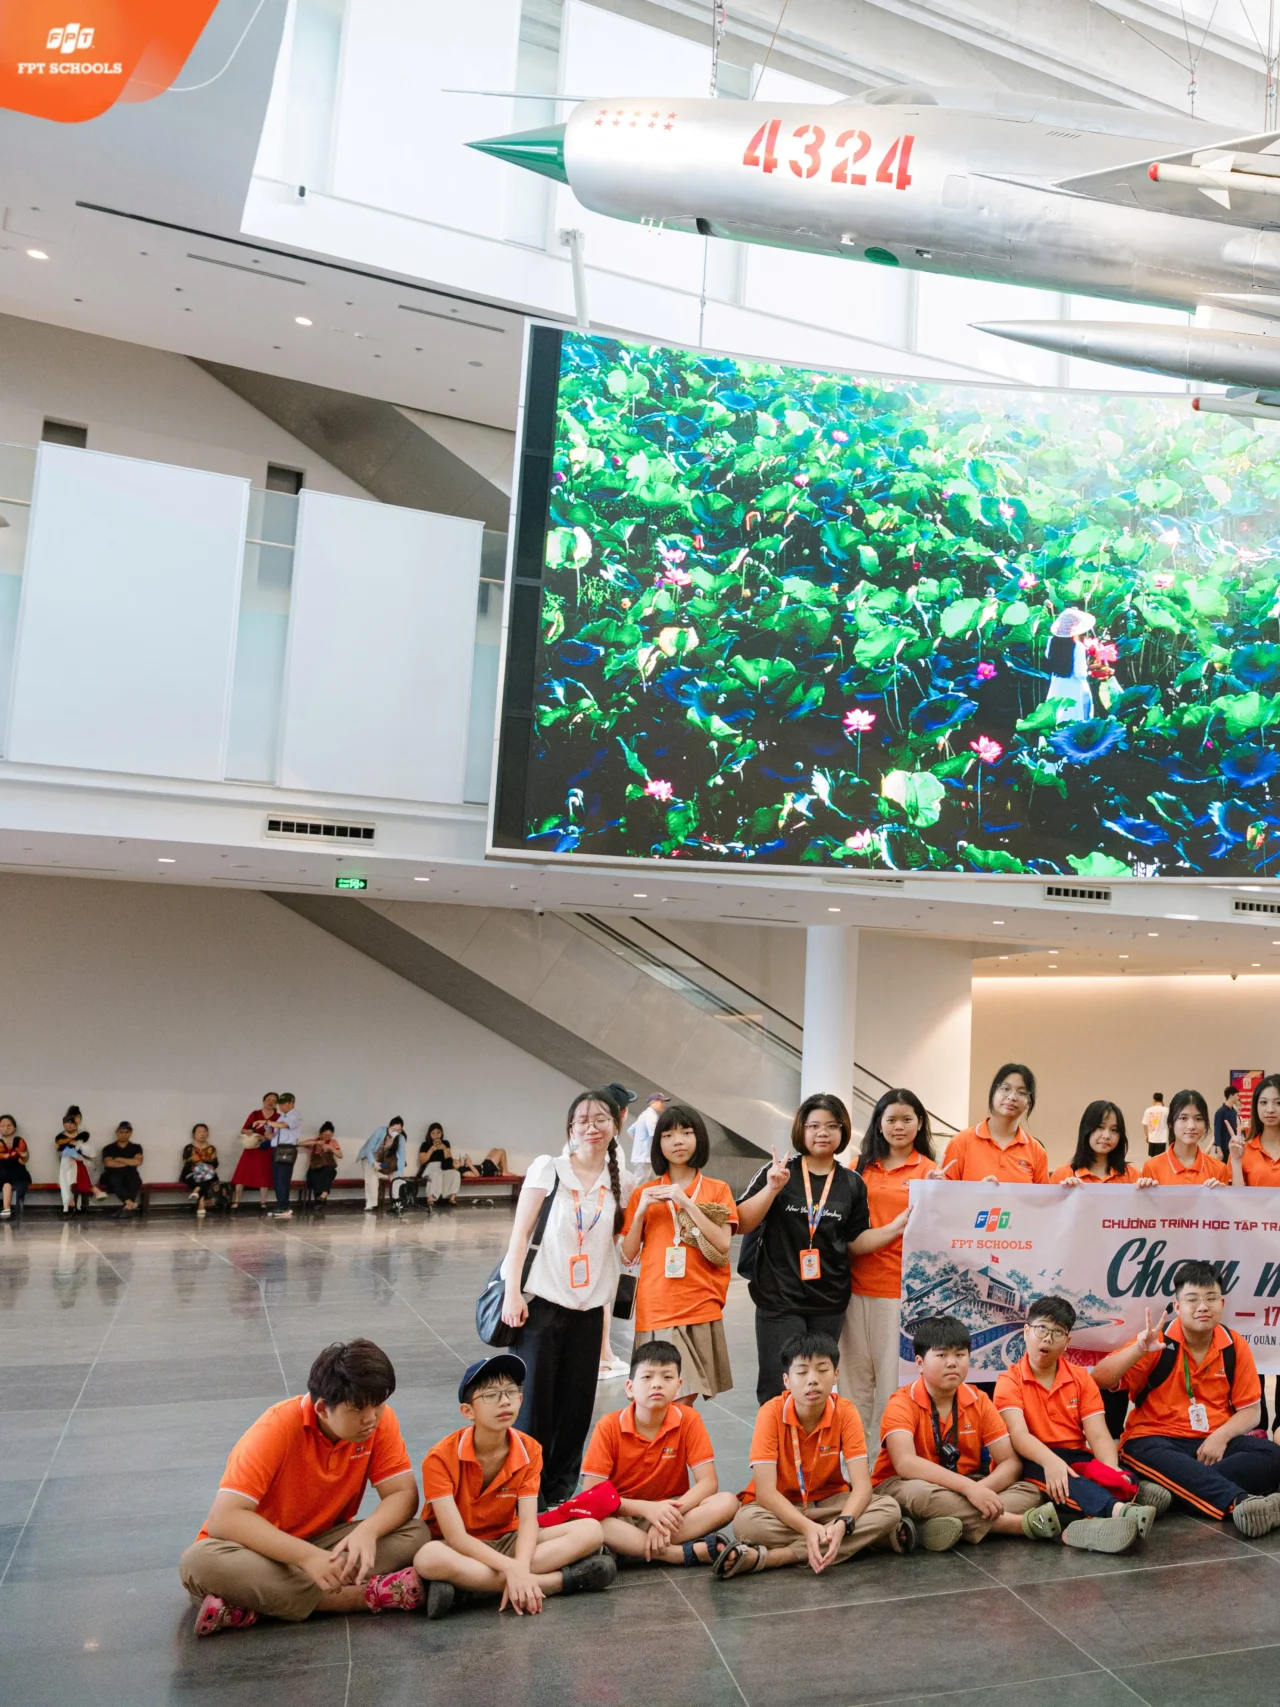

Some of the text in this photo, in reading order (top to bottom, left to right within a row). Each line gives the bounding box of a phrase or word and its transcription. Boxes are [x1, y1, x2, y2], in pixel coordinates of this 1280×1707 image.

[742, 118, 916, 191] 4324
[1102, 1217, 1157, 1229] CHƯƠNG
[1160, 1217, 1199, 1229] TRÌNH
[1202, 1220, 1230, 1231] HỌC
[1234, 1219, 1258, 1232] TẬP
[951, 1239, 1033, 1250] FPT SCHOOLS
[1253, 1334, 1277, 1346] QUÂN
